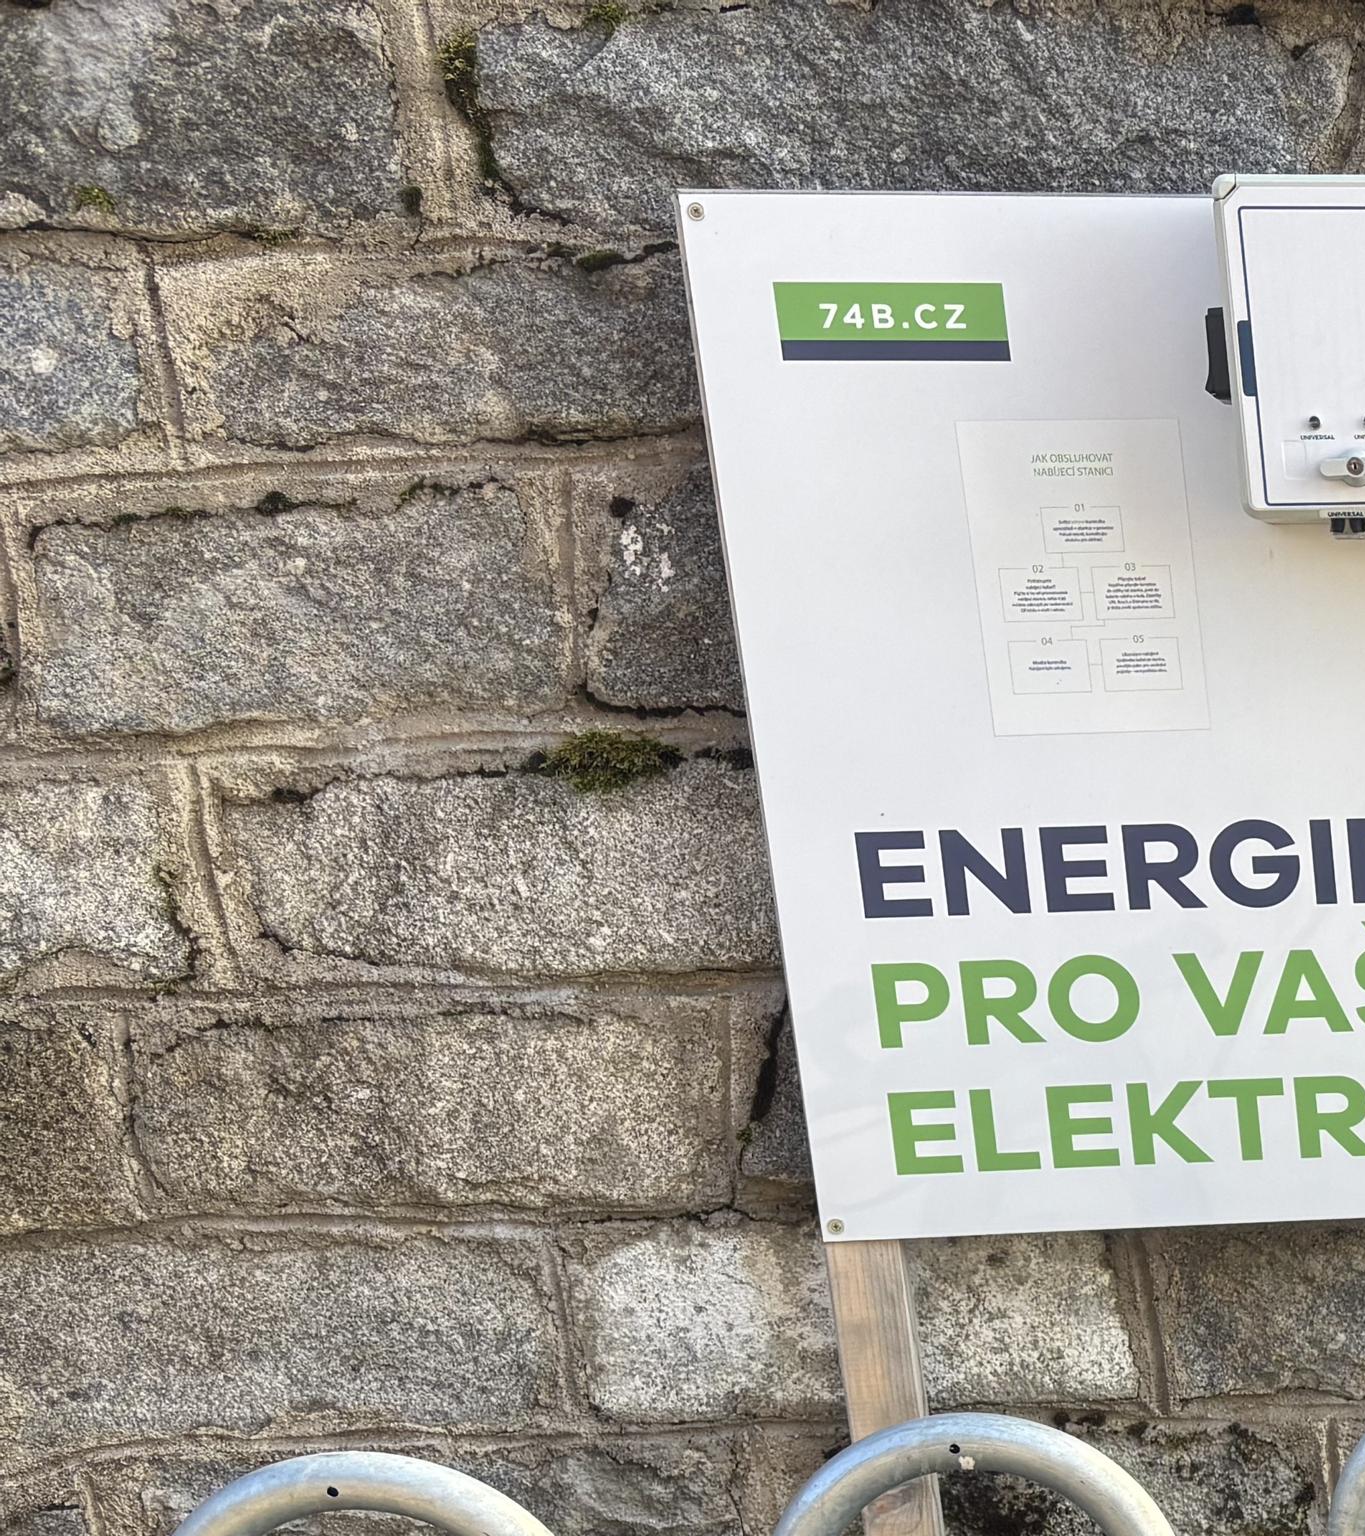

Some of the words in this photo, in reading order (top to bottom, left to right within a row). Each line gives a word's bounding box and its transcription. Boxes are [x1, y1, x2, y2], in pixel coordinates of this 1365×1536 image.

[818, 303, 967, 329] 74B.CZ
[1031, 453, 1048, 464] JAK
[1049, 452, 1113, 464] OBSLUHOVAT
[1077, 466, 1114, 476] STANICI
[1074, 503, 1086, 512] 01
[1032, 564, 1044, 574] 02
[1124, 562, 1137, 572] 03
[1041, 637, 1053, 646] 04
[1132, 634, 1145, 643] 05
[870, 954, 1140, 1049] PRO
